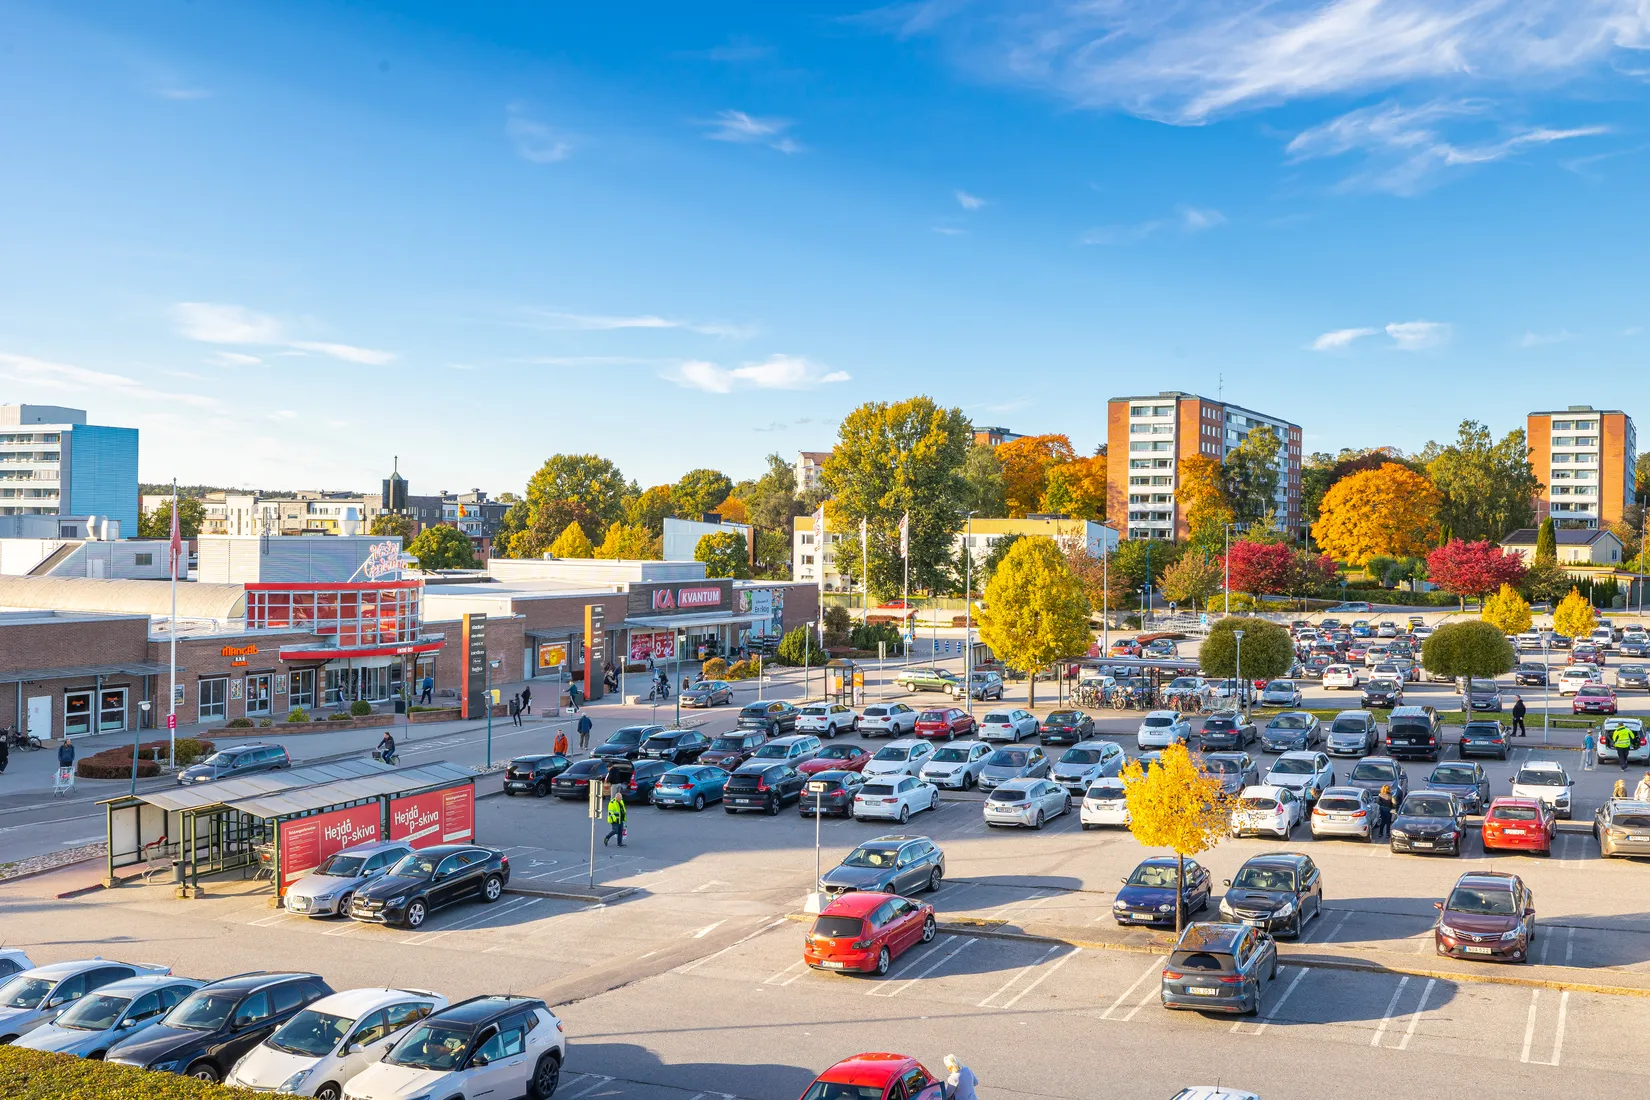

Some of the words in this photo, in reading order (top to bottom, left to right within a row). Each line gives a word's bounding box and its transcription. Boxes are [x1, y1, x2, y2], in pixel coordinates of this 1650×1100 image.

[652, 589, 675, 609] ICA
[682, 591, 719, 604] KVANTUM
[394, 804, 419, 826] Hejdå
[409, 811, 439, 833] p-skiva
[324, 818, 352, 841] Hejdå
[341, 824, 376, 849] p-skiva
